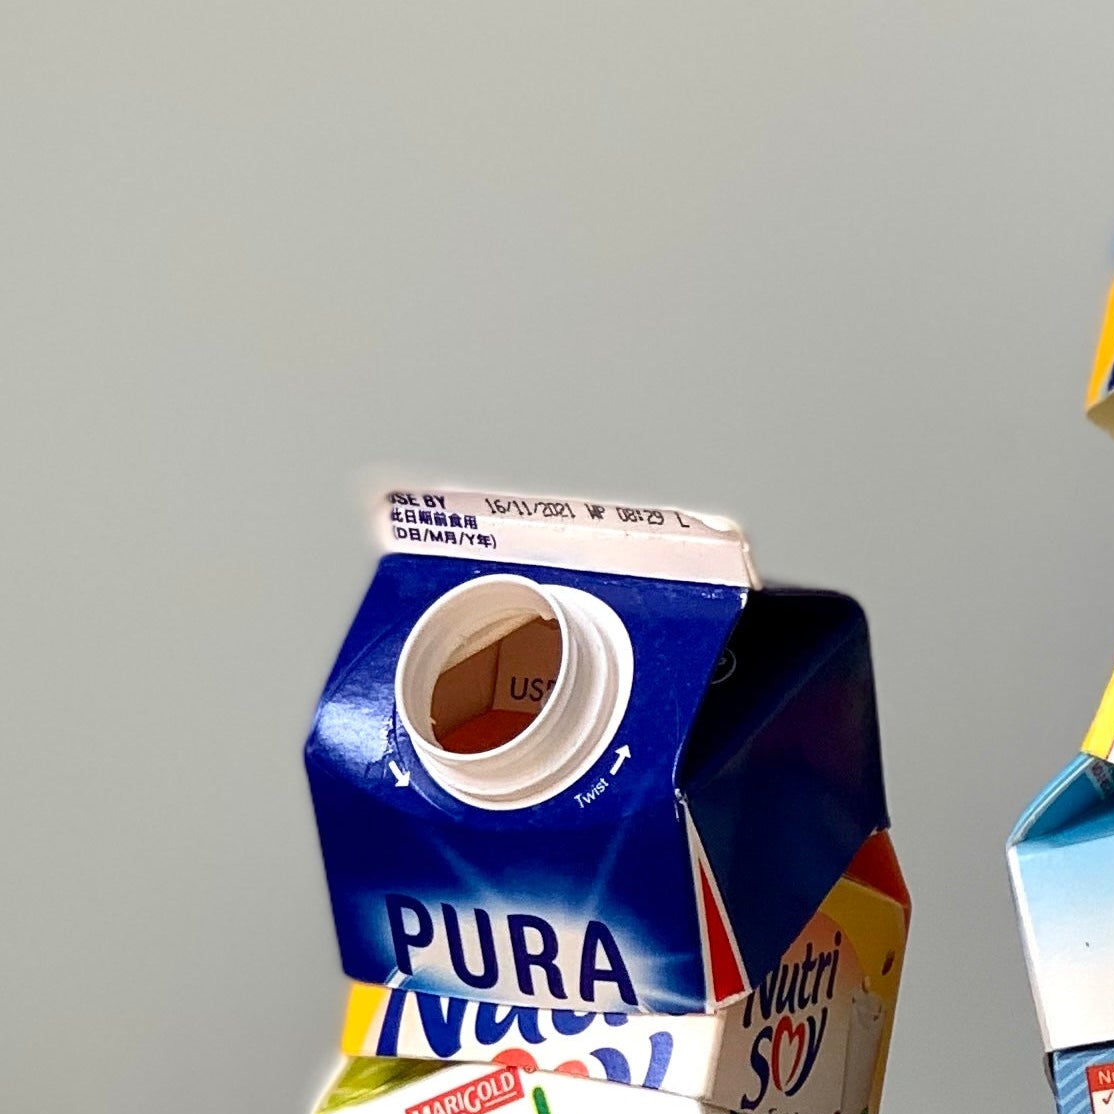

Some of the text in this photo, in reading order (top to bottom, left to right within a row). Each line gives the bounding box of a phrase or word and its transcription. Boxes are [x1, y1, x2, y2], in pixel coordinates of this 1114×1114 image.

[424, 494, 447, 509] BY
[573, 777, 610, 809] Twist
[385, 893, 639, 1006] PURA
